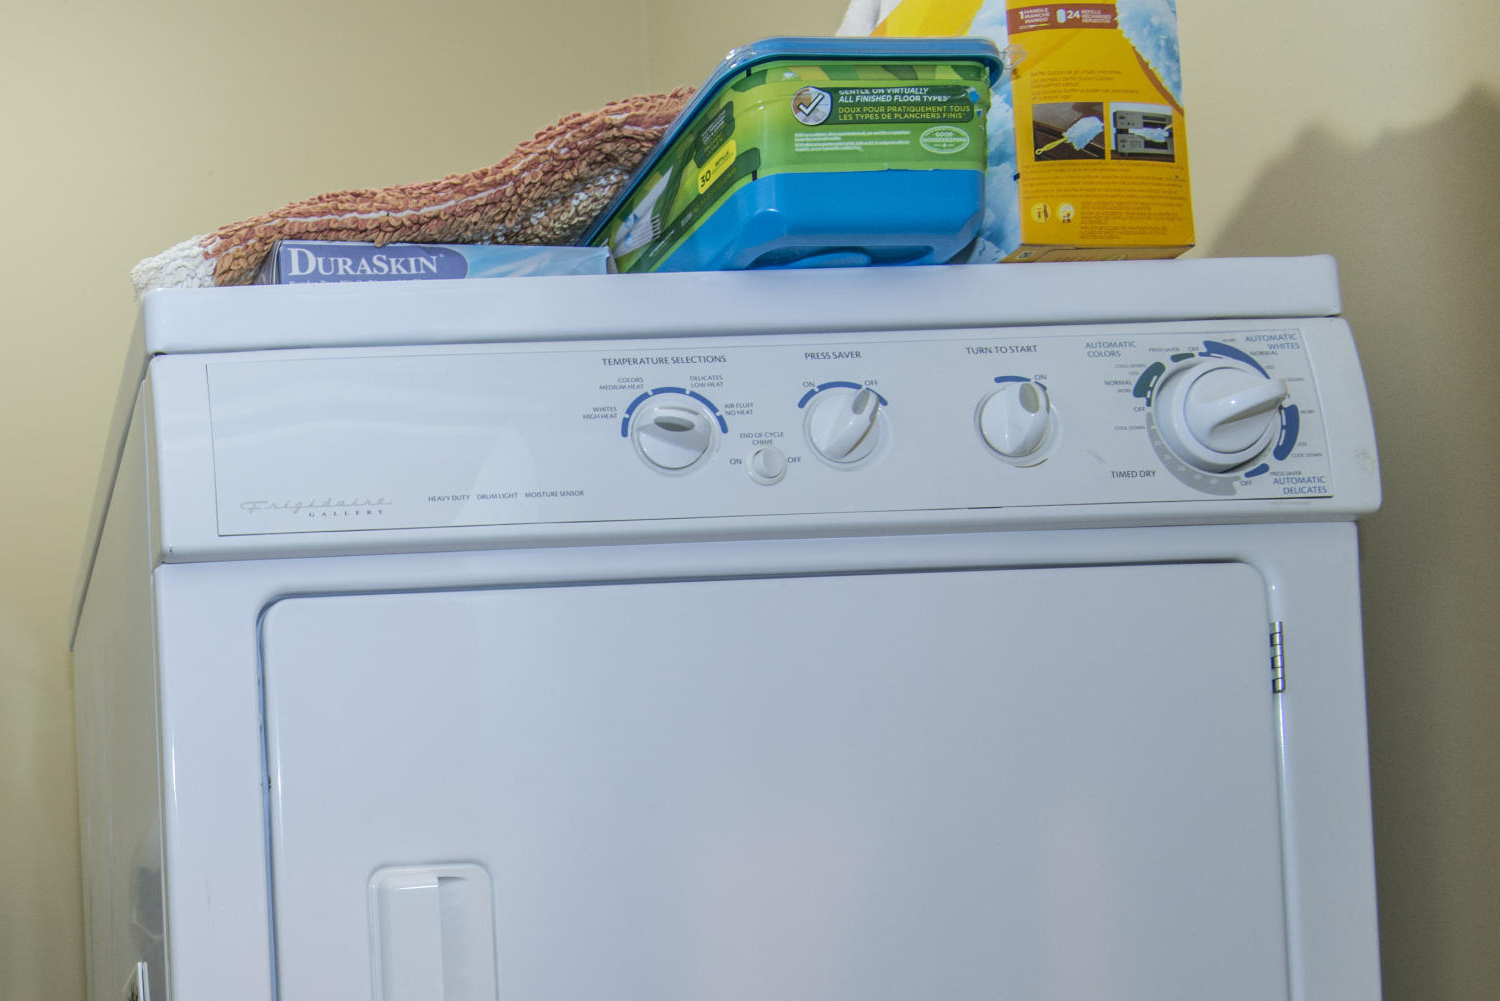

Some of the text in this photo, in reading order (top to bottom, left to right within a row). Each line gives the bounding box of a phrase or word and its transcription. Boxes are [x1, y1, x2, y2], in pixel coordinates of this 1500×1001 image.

[1067, 10, 1080, 19] 24
[838, 106, 861, 114] DOUX
[700, 170, 712, 188] 30
[1244, 334, 1297, 342] AUTOMATIC
[1085, 341, 1136, 349] AUTOMATIC
[1268, 342, 1300, 350] WHITES
[966, 345, 1038, 355] TURN TO START
[1087, 350, 1121, 358] COLORS
[804, 351, 862, 360] PRESS SAVER
[602, 355, 727, 366] TEMPERATURE SELECTIONS
[1111, 470, 1156, 478] TIMED DRY
[1273, 476, 1325, 484] AUTOMATIC
[1284, 486, 1327, 494] DELICATES
[240, 498, 392, 513] Frigidaire
[308, 508, 384, 518] GALLERY
